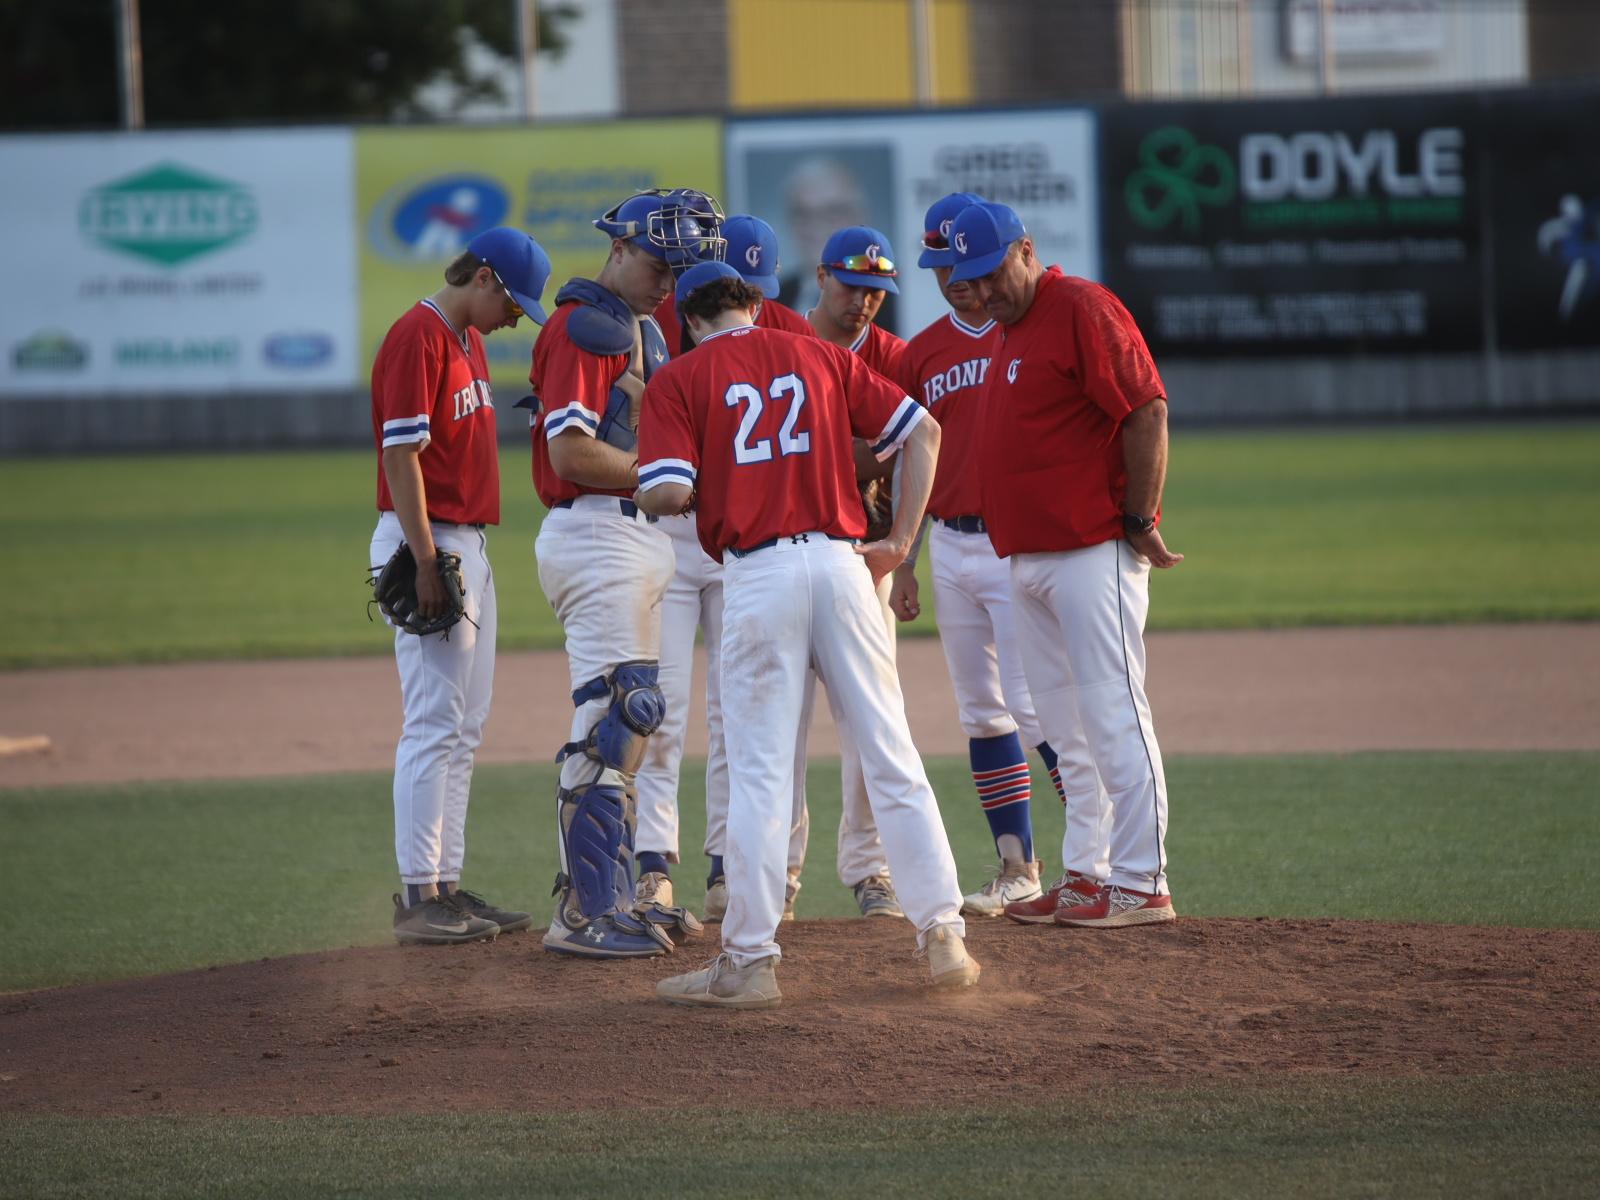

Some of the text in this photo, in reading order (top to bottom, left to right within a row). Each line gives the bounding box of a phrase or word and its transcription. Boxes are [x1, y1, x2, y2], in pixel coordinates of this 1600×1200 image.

[1240, 128, 1465, 198] DOYLE
[80, 195, 257, 235] IRVING
[724, 372, 811, 465] 22
